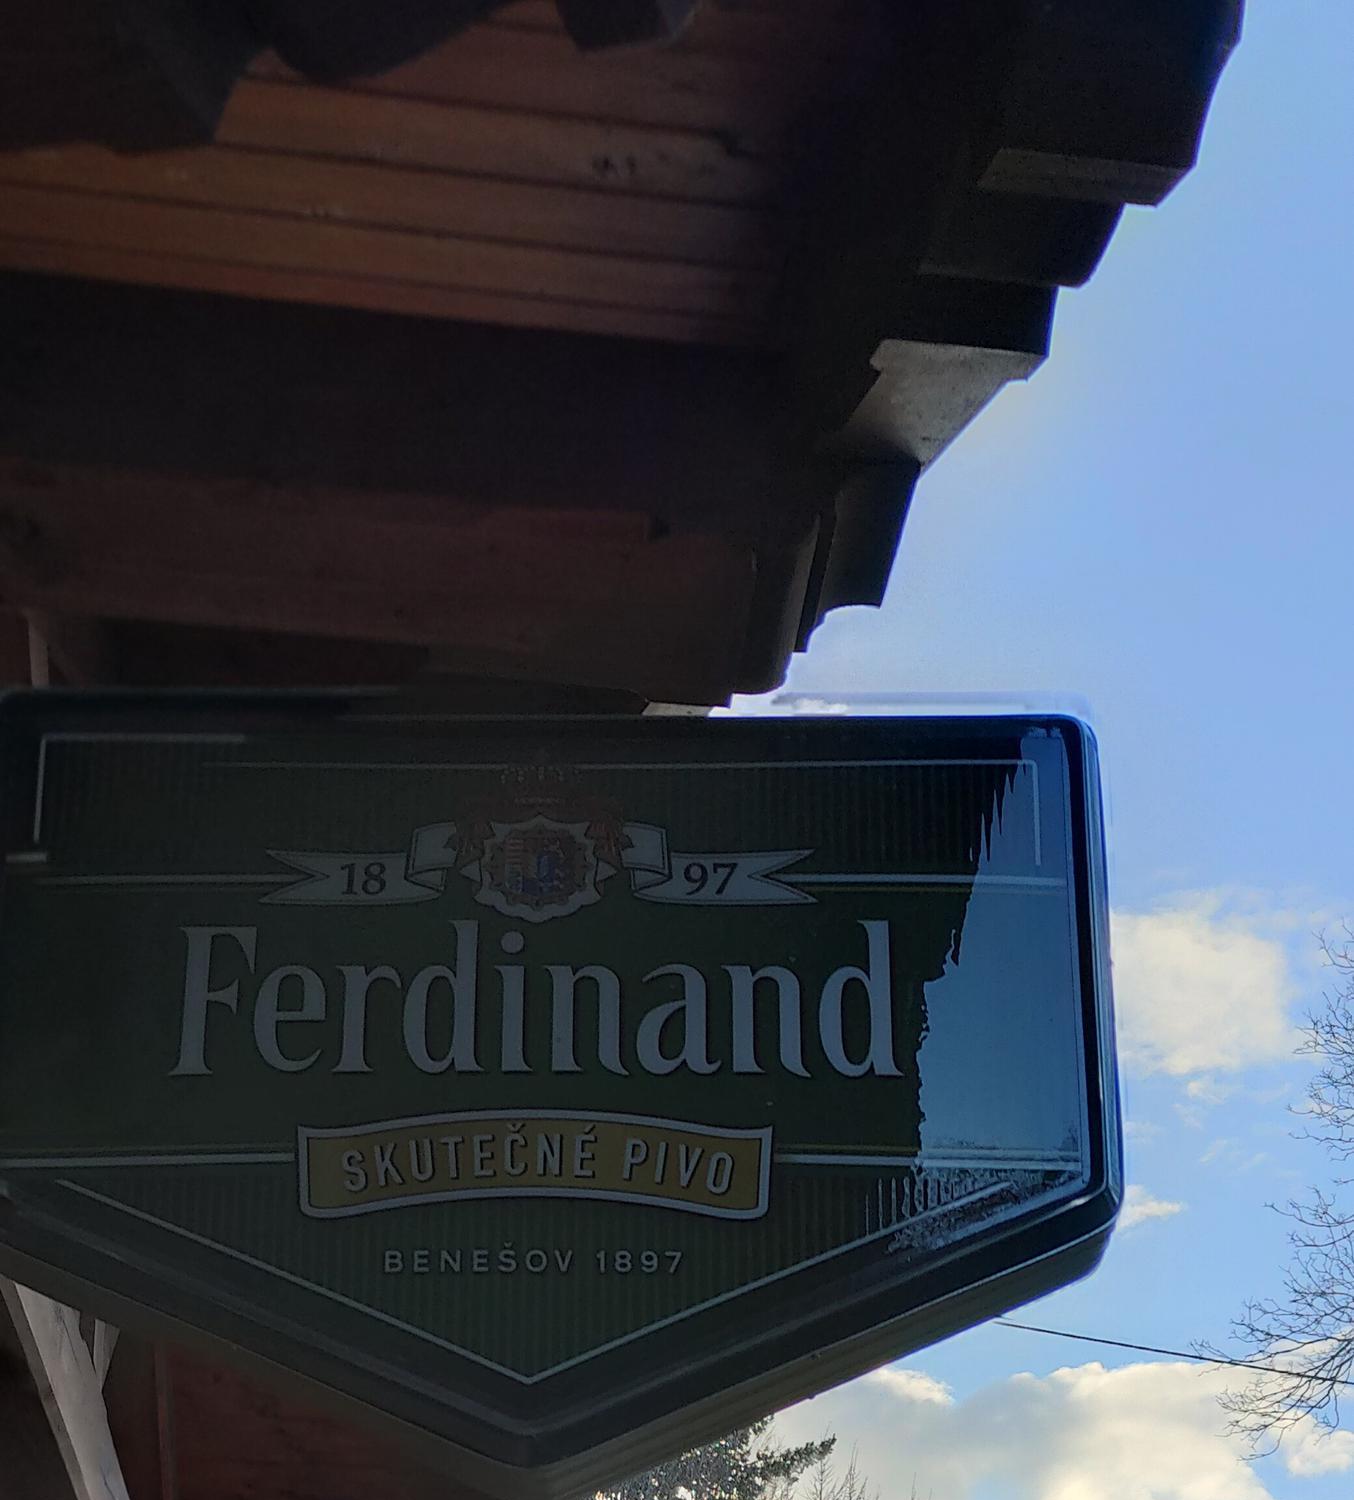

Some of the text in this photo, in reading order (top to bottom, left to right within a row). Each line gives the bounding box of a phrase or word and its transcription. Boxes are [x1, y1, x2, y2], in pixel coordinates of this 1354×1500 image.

[341, 861, 737, 896] 18 97
[168, 918, 905, 1079] Ferdinand
[342, 1123, 735, 1195] SKUTEČNÉ PIVO
[384, 1241, 685, 1274] BENEŠOV 1897
